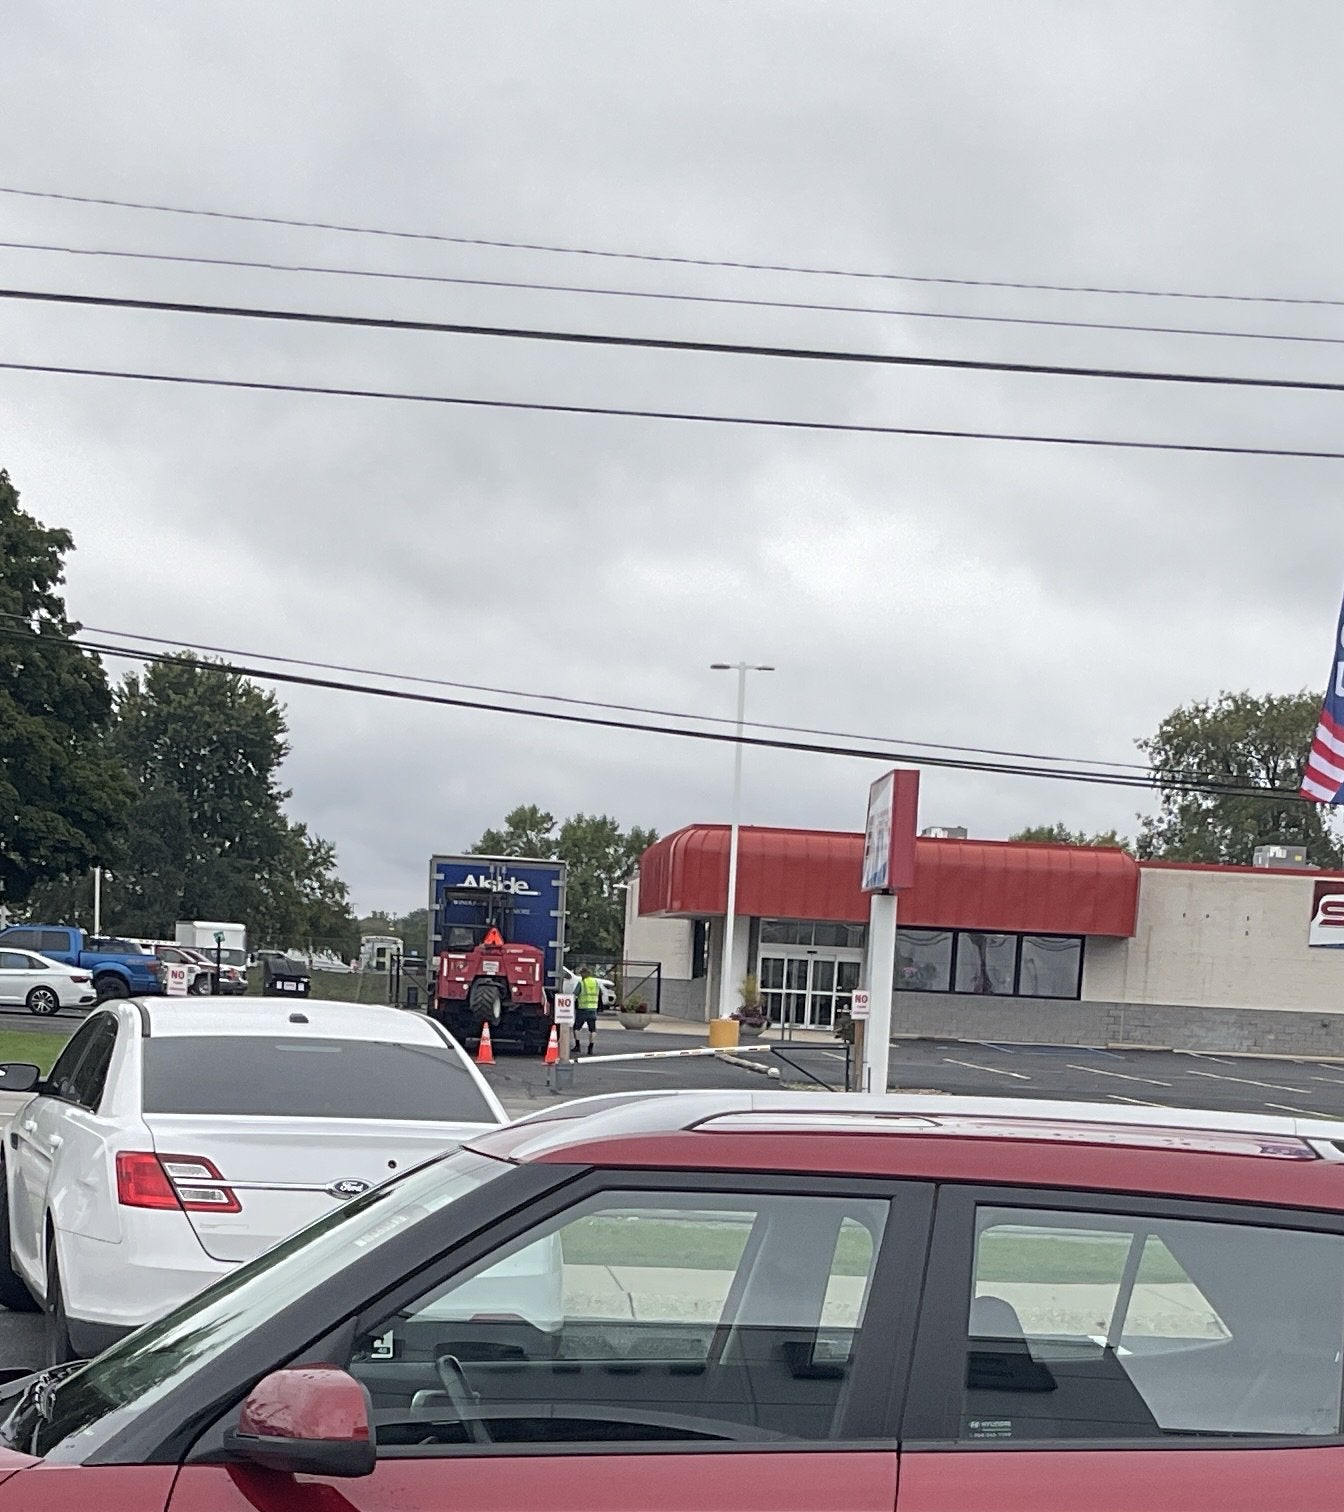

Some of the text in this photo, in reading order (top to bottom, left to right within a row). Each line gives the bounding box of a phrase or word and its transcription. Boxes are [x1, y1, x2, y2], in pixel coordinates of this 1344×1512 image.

[171, 970, 185, 980] NO
[557, 998, 572, 1008] NO
[855, 994, 868, 1004] NO
